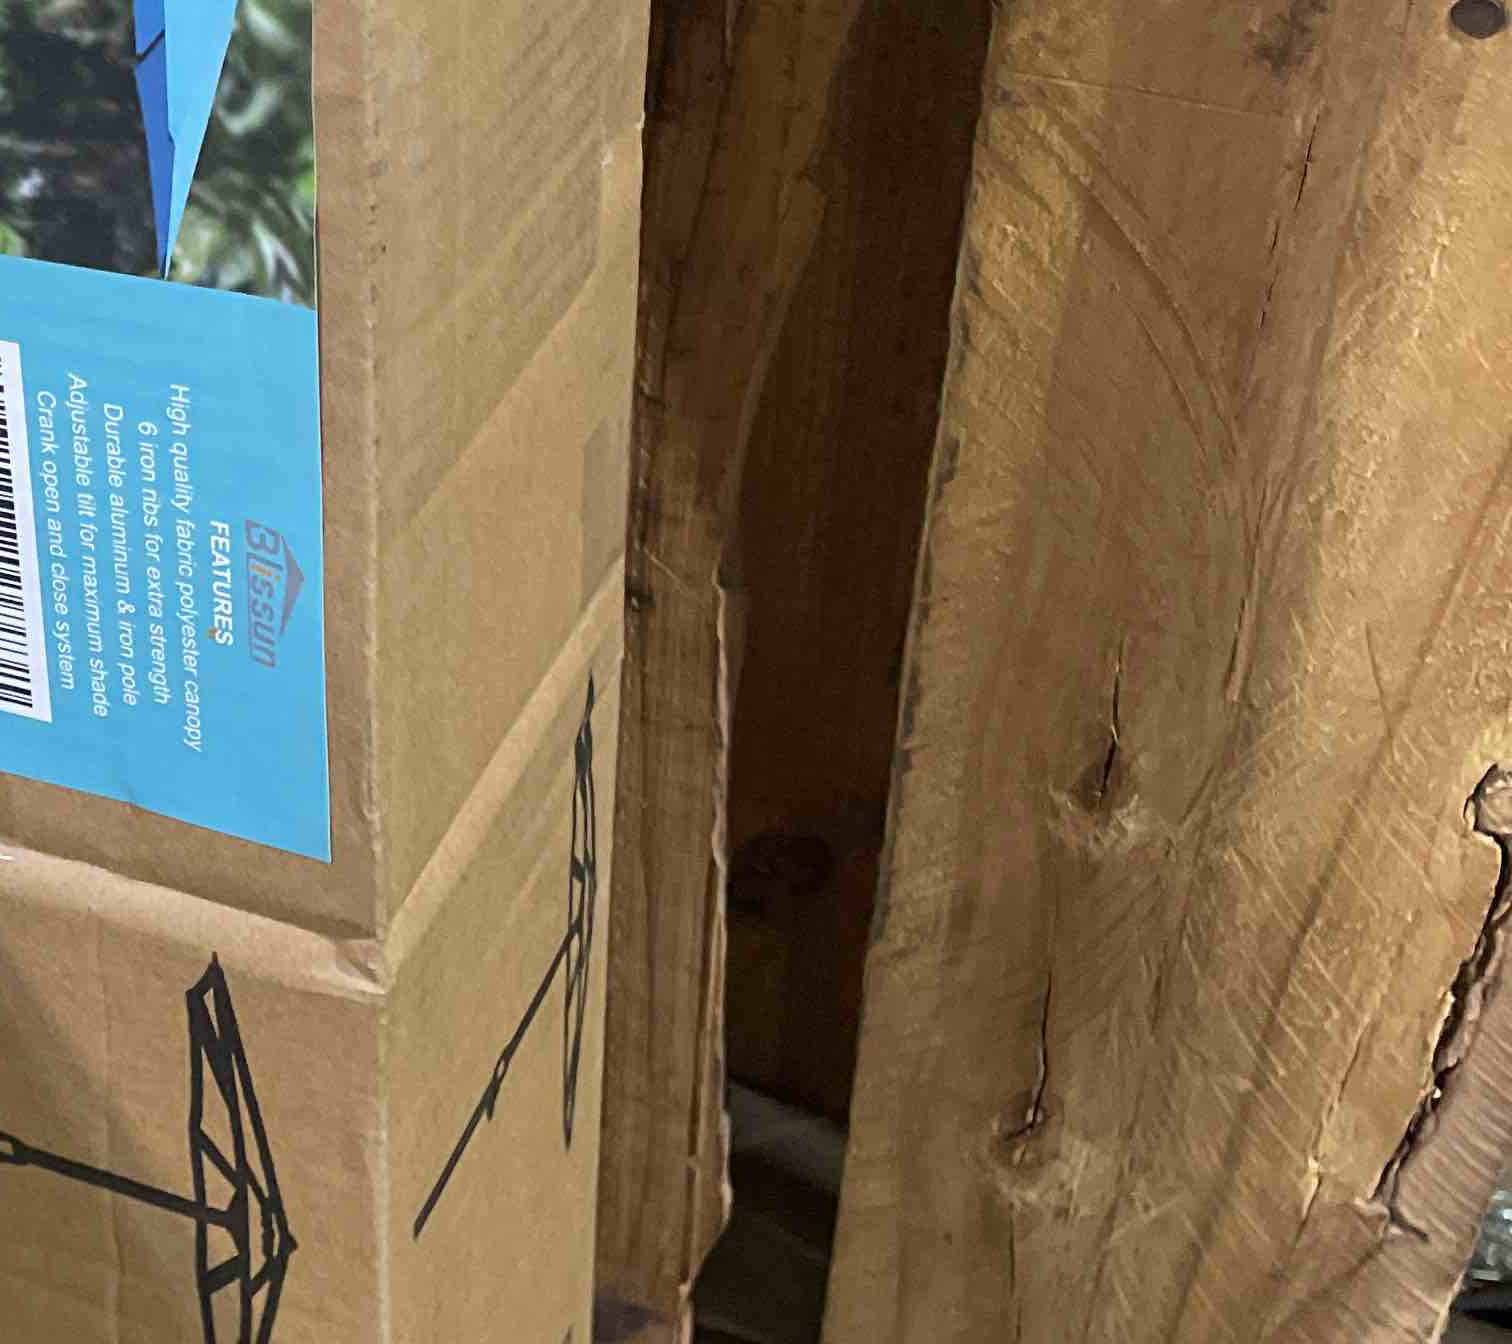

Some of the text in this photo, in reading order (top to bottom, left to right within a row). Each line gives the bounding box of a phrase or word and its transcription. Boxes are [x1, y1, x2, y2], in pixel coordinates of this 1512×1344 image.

[37, 389, 75, 691] Crank open and close system
[65, 371, 111, 719] Adjustable tilt for maximum shade
[103, 403, 140, 706] Durable aluminum & iron pole
[138, 421, 172, 706] 6 iron ribs for extra strength
[166, 384, 202, 752] High quality fabric polyester canopy
[208, 520, 233, 647] FEATURES
[245, 519, 281, 669] Blissun
